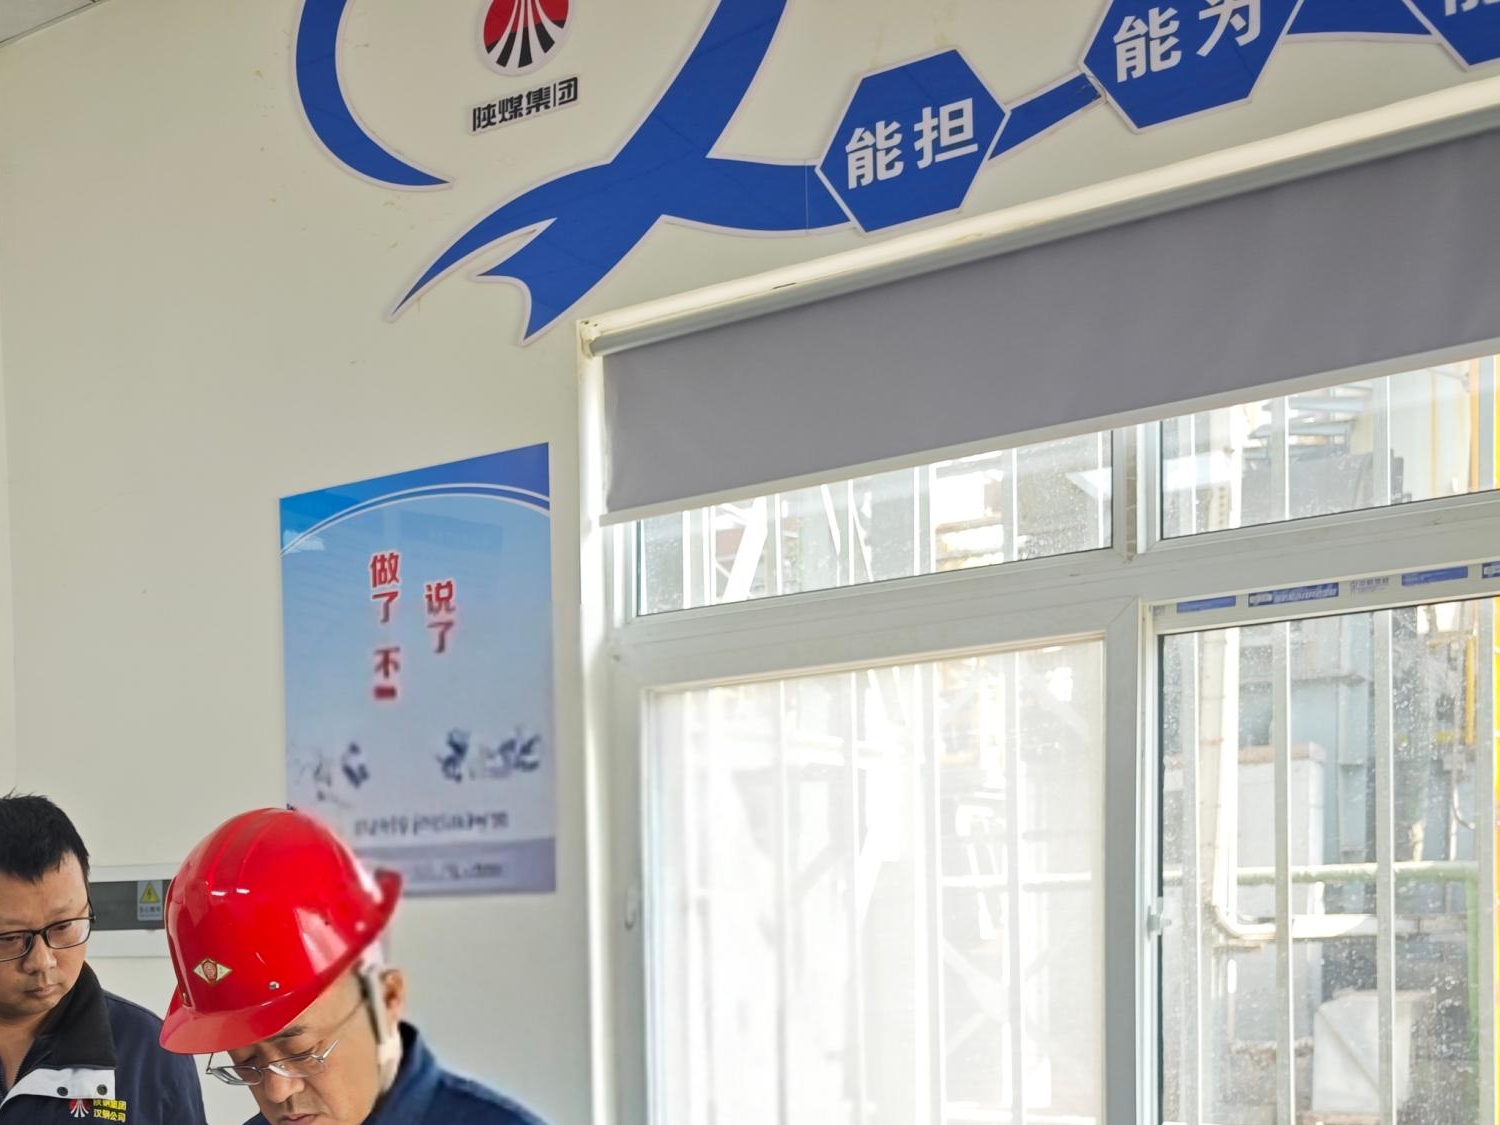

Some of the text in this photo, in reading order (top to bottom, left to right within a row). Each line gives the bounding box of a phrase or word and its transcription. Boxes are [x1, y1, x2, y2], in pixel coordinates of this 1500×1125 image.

[1113, 0, 1261, 83] 能为
[472, 76, 578, 132] 陕煤集团
[845, 97, 979, 190] 能担
[424, 581, 456, 655] 说了
